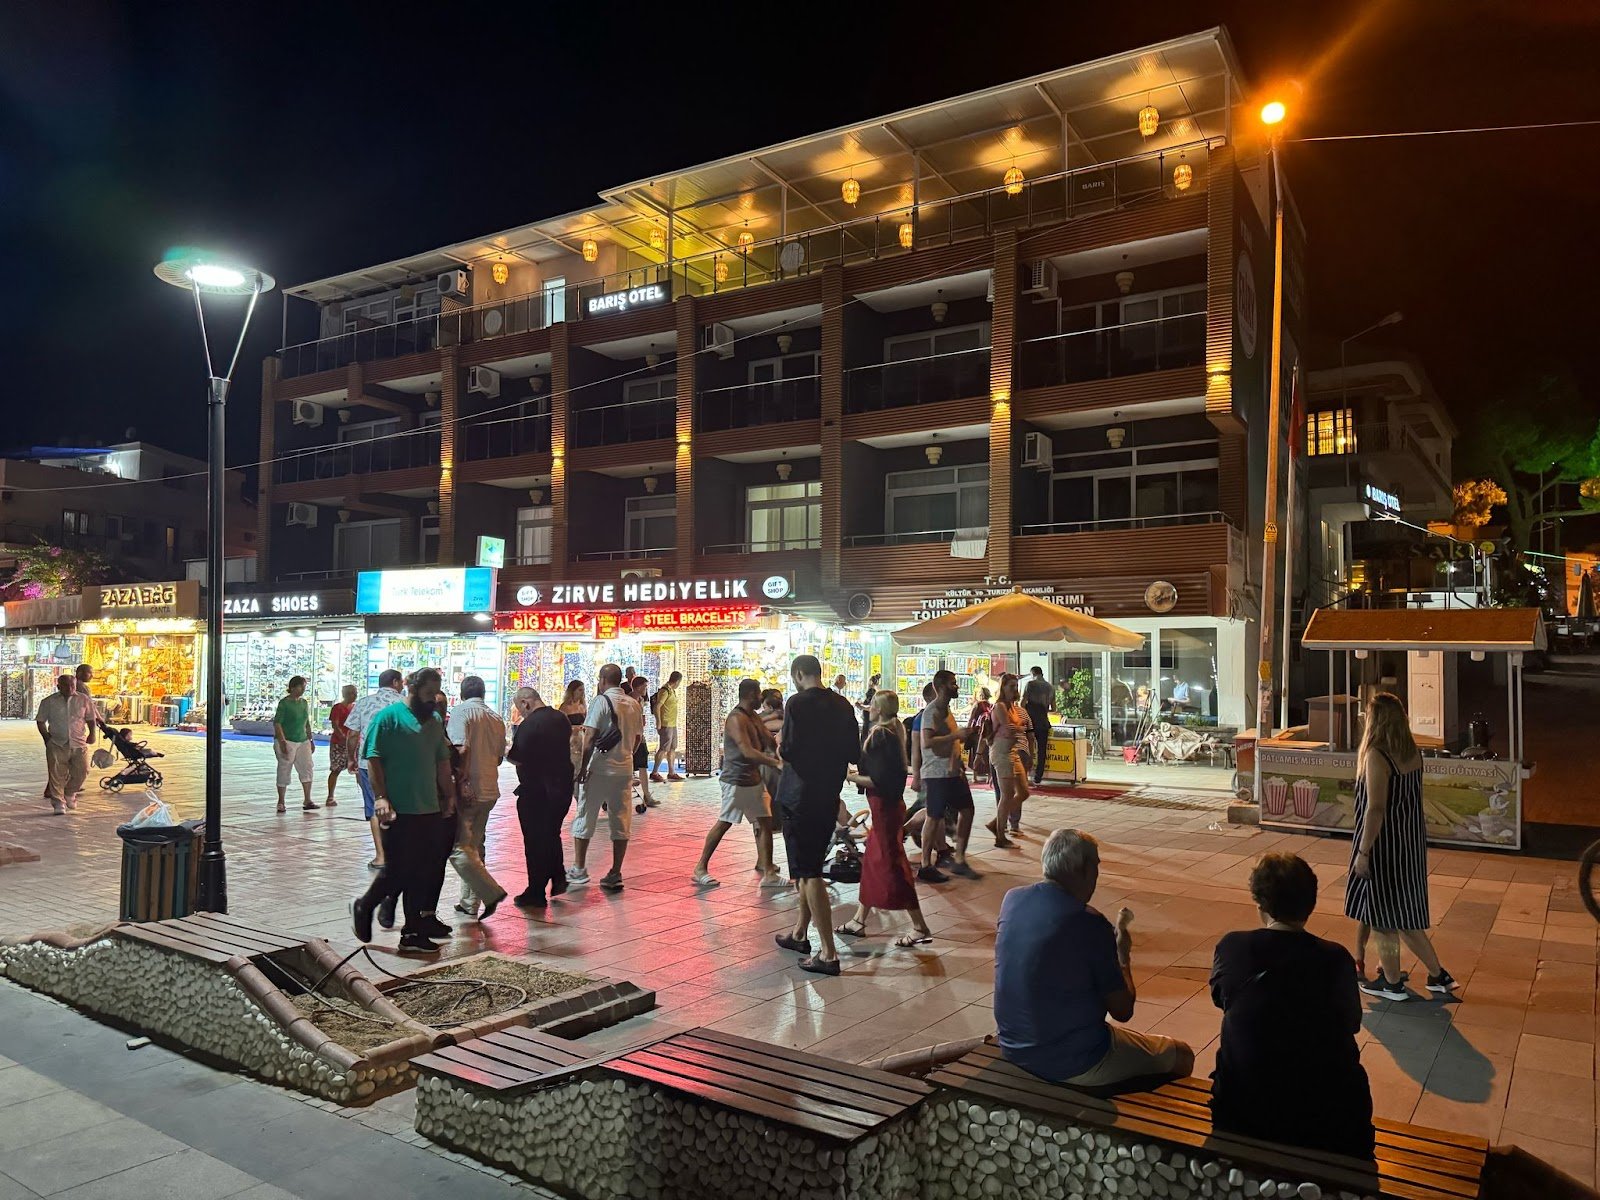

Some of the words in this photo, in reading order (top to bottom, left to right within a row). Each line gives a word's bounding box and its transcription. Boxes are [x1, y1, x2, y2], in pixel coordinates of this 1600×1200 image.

[588, 291, 627, 311] BARIŞ
[629, 285, 663, 303] OTEL
[767, 580, 783, 588] GIFT
[984, 576, 1012, 586] T.C.
[223, 598, 260, 614] ZAZA
[272, 595, 319, 612] SHOES
[513, 614, 540, 630] BIG
[643, 612, 679, 625] STEEL
[680, 610, 746, 623] BRACELETS
